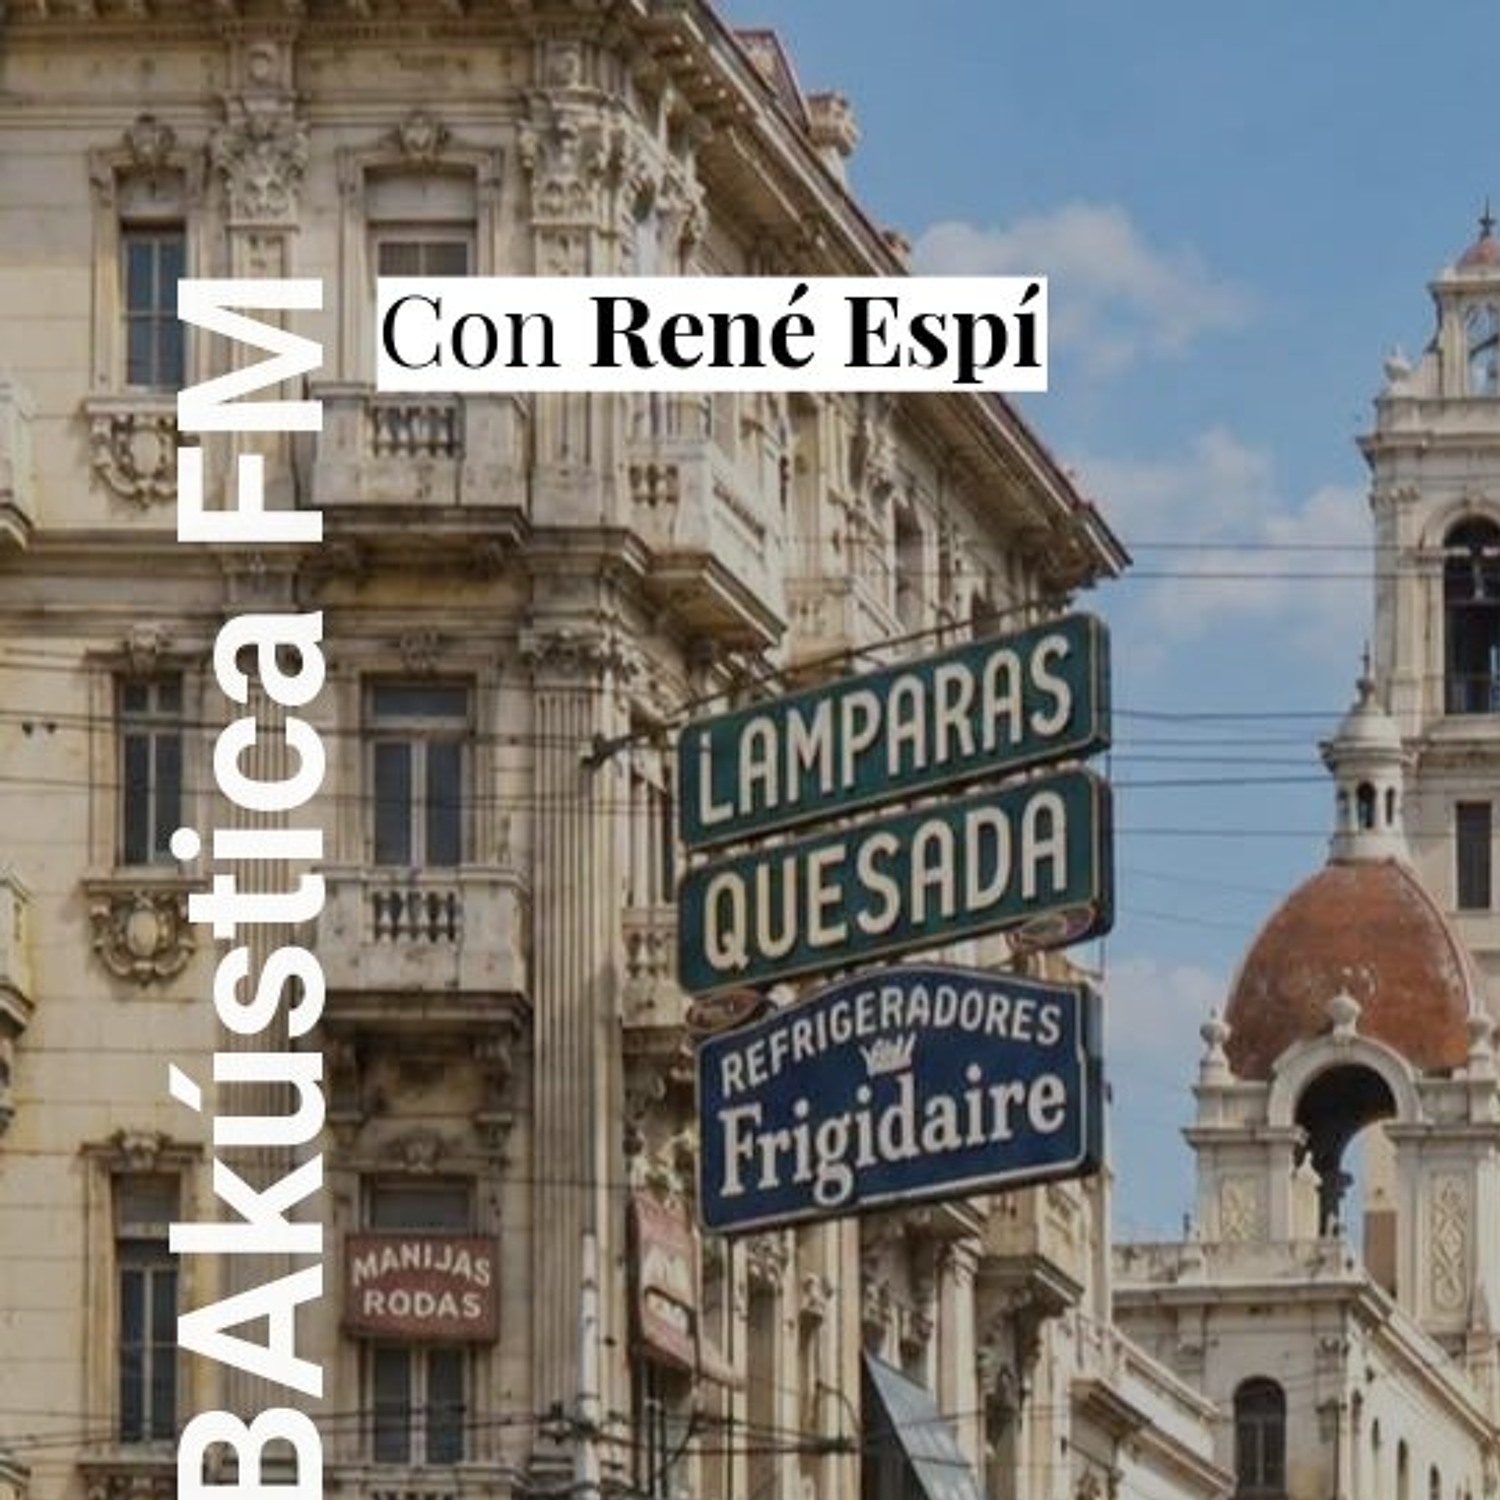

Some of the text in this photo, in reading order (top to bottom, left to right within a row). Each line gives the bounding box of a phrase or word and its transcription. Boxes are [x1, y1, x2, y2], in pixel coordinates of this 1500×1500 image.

[701, 632, 1072, 825] LAMPARAS
[704, 792, 1066, 972] QUESADA
[720, 983, 1062, 1098] REFRIGERADORES
[717, 1060, 1067, 1207] Frigidaire
[352, 1242, 491, 1287] MANIJAS
[363, 1289, 482, 1318] RODAS
